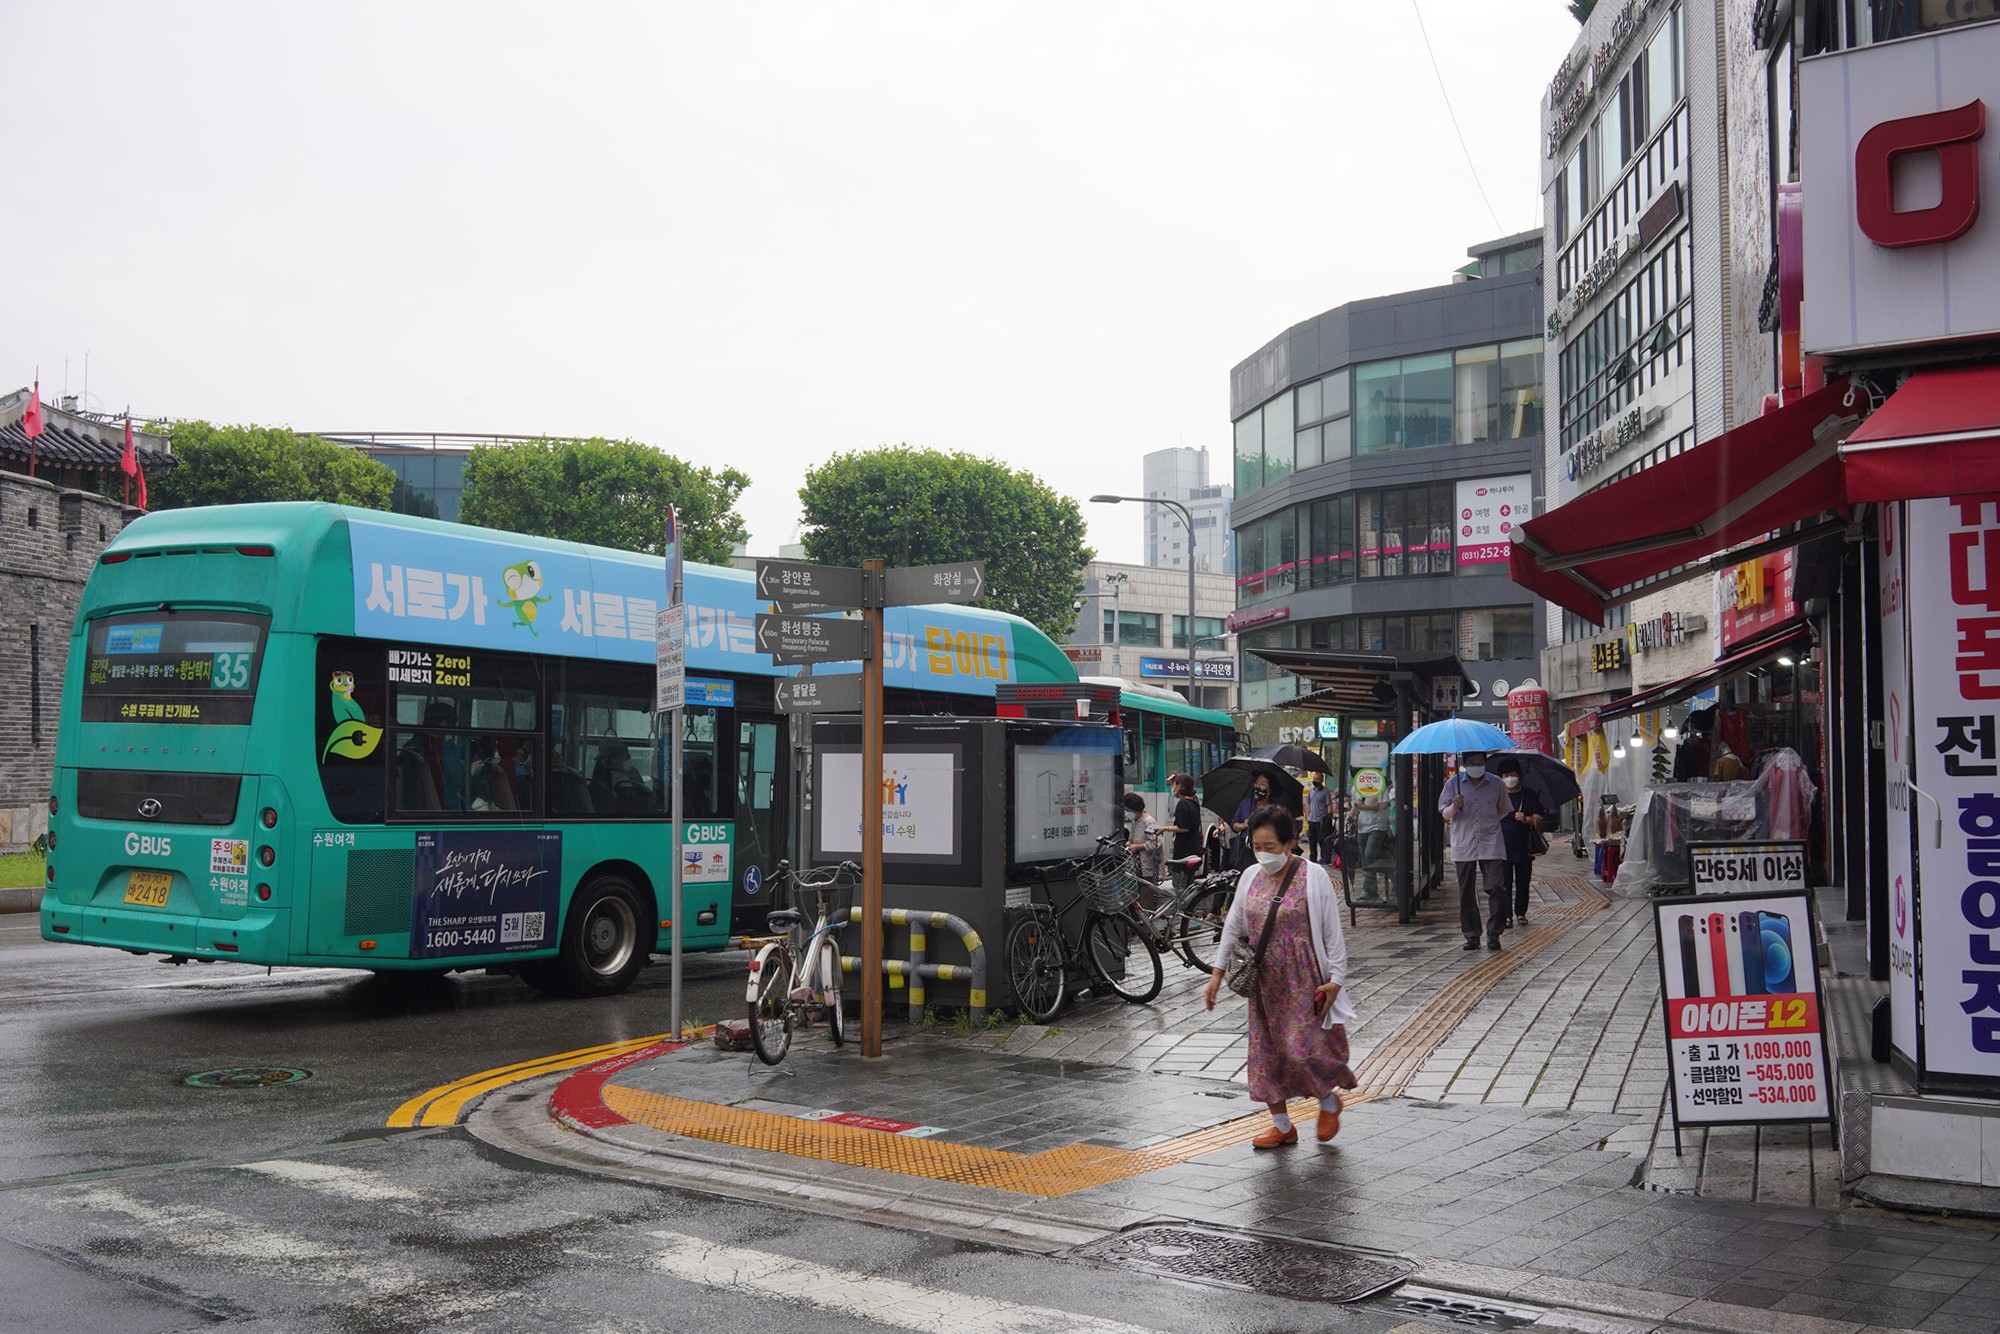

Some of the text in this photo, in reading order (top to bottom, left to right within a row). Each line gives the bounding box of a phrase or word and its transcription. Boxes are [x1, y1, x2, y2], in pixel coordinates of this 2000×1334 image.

[1490, 485, 1514, 494] 하나투어
[1475, 508, 1490, 518] 여행
[1514, 504, 1529, 514] 항공
[1475, 525, 1490, 535] 호텔
[782, 570, 812, 586] 장안문
[933, 572, 962, 586] 화장실
[366, 562, 488, 627] 서로가
[782, 587, 820, 596] Janganmun Gate
[948, 588, 961, 596] Toilet
[781, 620, 822, 637] 화성행궁
[782, 636, 809, 647] Temporary
[810, 638, 824, 646] Palace
[782, 644, 807, 654] Hwaseong
[388, 650, 471, 670] 배기가스 Zero!
[925, 626, 1008, 682] 답이다
[130, 665, 145, 678] 수원역
[180, 660, 212, 681] 향남택지
[214, 653, 250, 688] 35
[388, 667, 471, 687] 미세먼지 Zero!
[1203, 663, 1232, 678] 우리은행
[792, 684, 817, 698] 팔달문
[1016, 688, 1066, 699] TELEPHONE
[1509, 694, 1542, 706] 사주타로
[121, 704, 200, 718] 수원 무공해 전기버스
[1888, 768, 1907, 812] world
[1060, 805, 1087, 816] MARKETING
[896, 824, 916, 838] 수원
[1043, 826, 1060, 840] 광고문의
[124, 832, 171, 856] GBUS
[213, 841, 233, 855] 주의
[313, 832, 355, 848] 수원여객
[468, 848, 491, 870] 가치
[1695, 856, 1802, 884] 만65세 이상
[209, 876, 248, 894] 수원여객
[428, 917, 442, 927] THE
[443, 916, 466, 926] SHARP
[504, 916, 519, 932] 5월
[426, 928, 496, 948] 1600-5440
[1892, 942, 1913, 979] SQUARE
[1744, 1040, 1812, 1060] 1,090,000
[1690, 1062, 1814, 1084] 클럽할인 -545,000
[1692, 1084, 1816, 1106] 선약할인 -534,000
